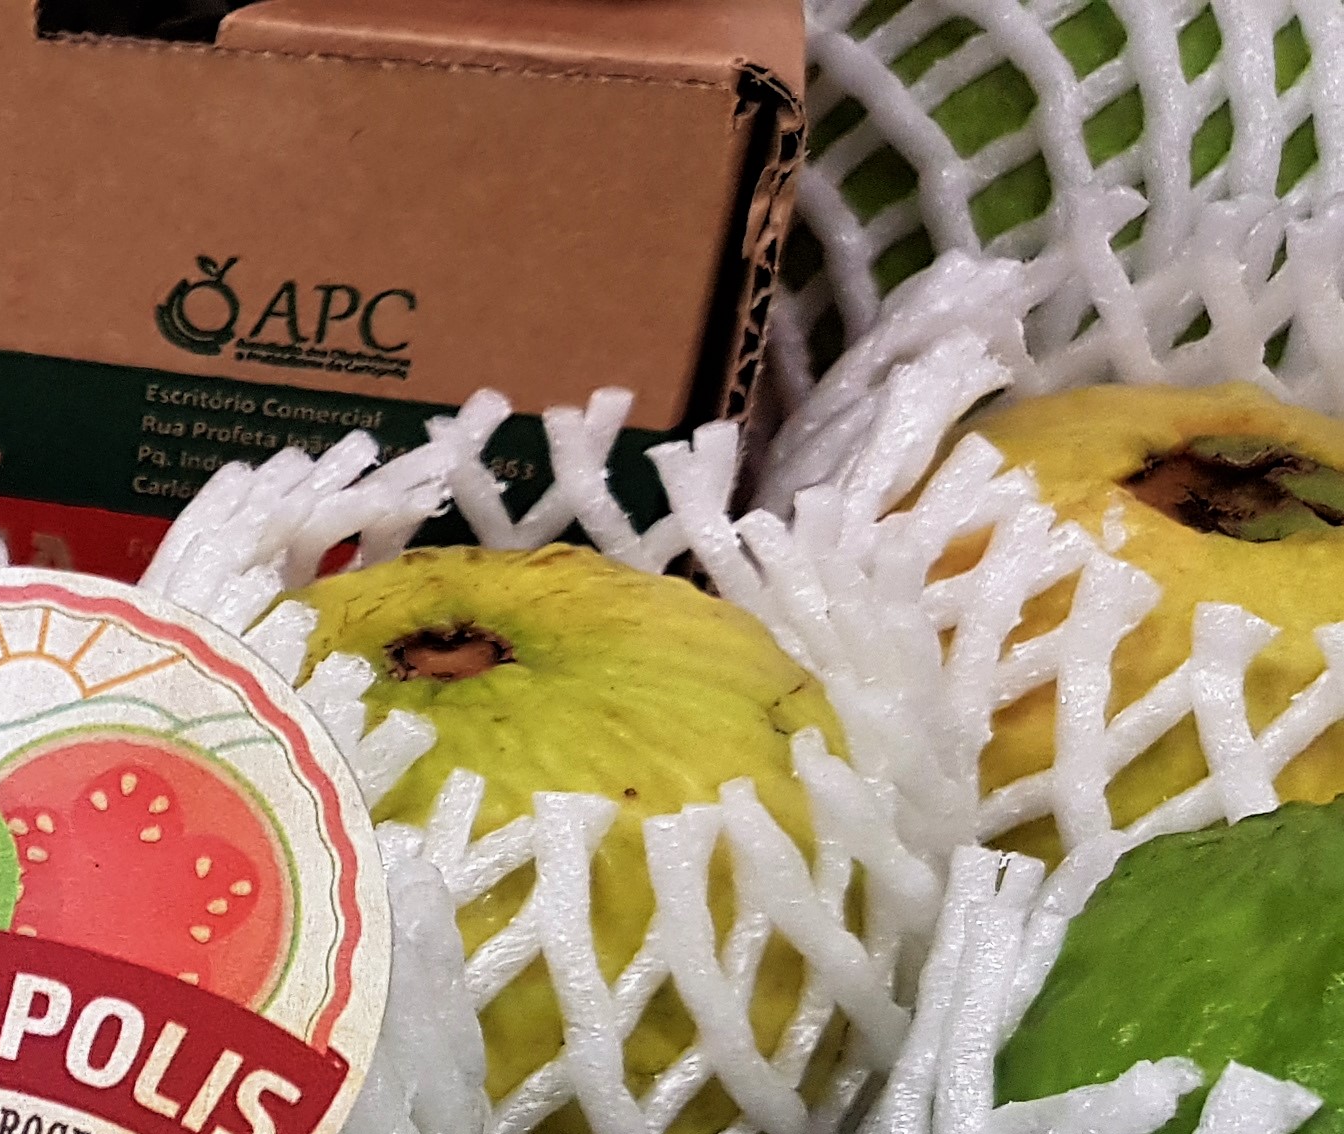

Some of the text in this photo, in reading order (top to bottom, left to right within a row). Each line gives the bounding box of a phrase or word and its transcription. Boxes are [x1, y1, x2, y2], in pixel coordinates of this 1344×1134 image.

[248, 279, 417, 353] APC
[145, 383, 384, 429] Escritório Comercial
[141, 414, 186, 438] Rua
[192, 421, 278, 449] Profeta
